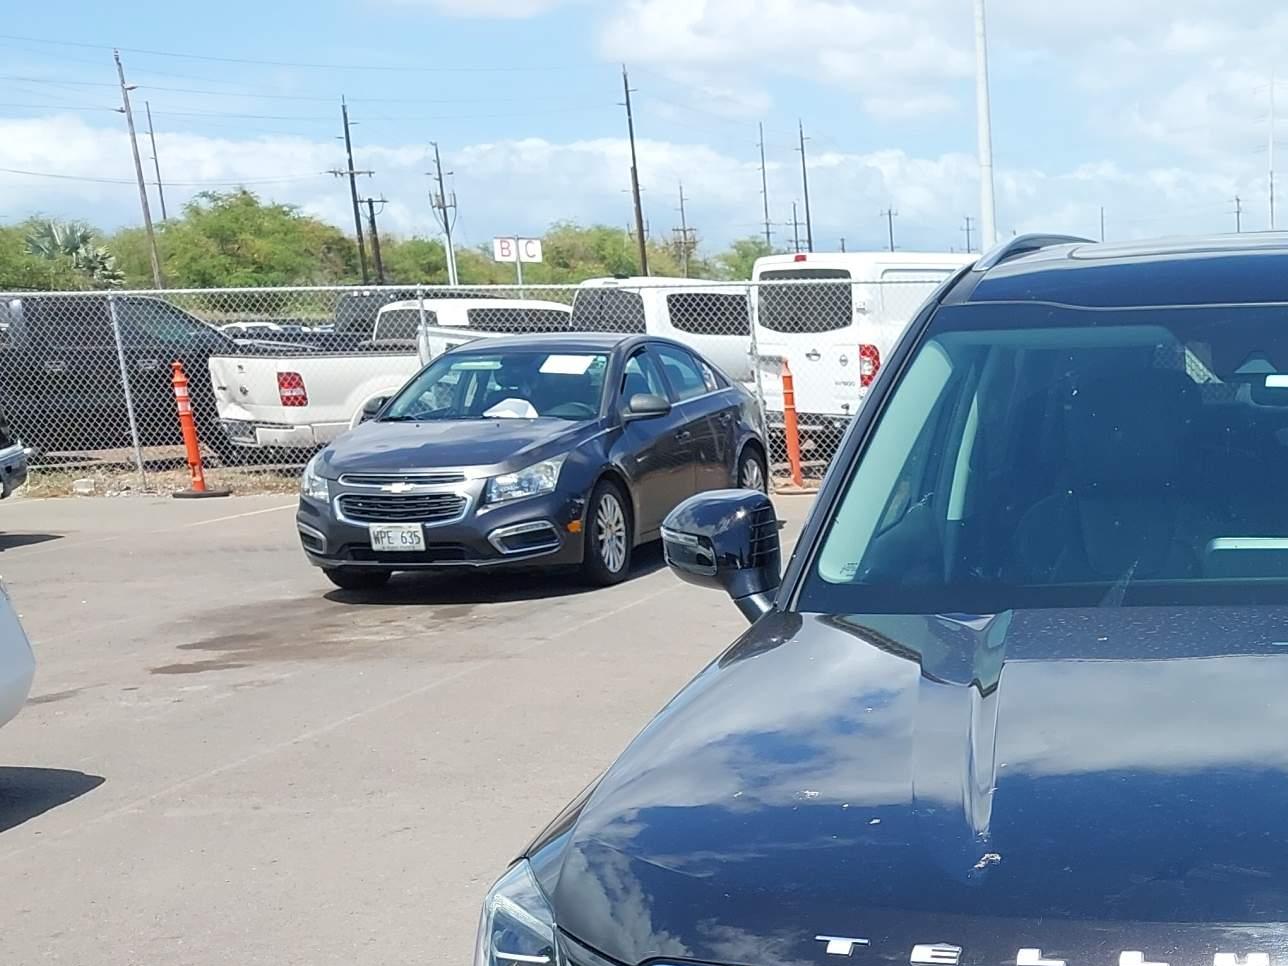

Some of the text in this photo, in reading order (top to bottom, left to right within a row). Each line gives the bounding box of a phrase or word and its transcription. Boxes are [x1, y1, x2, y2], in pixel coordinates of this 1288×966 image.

[499, 239, 512, 258] B
[525, 239, 537, 258] C
[400, 530, 421, 545] 635
